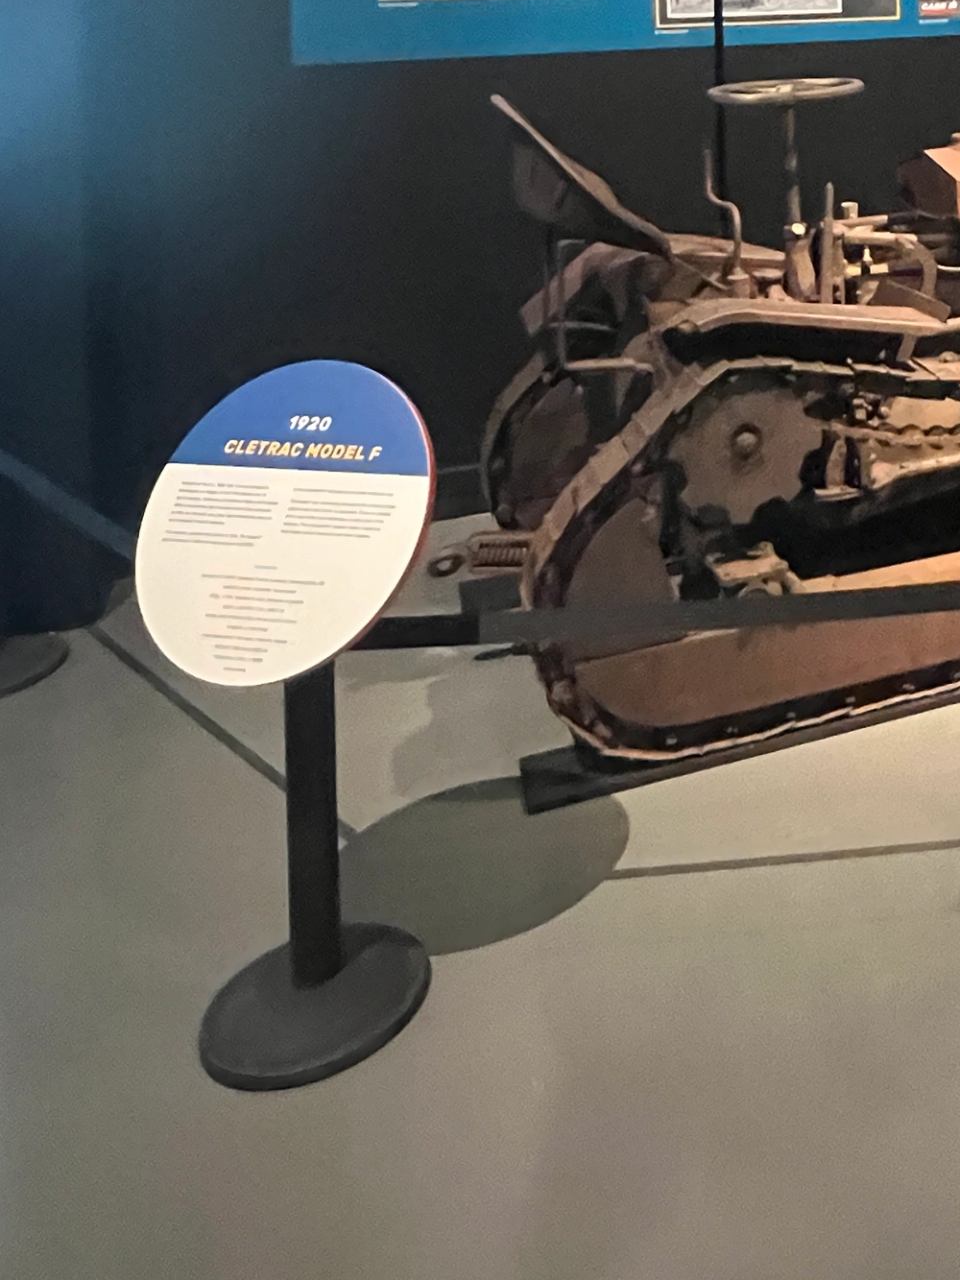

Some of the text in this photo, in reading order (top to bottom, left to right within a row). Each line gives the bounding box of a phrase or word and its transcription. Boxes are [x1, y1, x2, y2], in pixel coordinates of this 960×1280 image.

[288, 414, 333, 432] 1920
[223, 438, 384, 462] CLETRAC MODEL F
